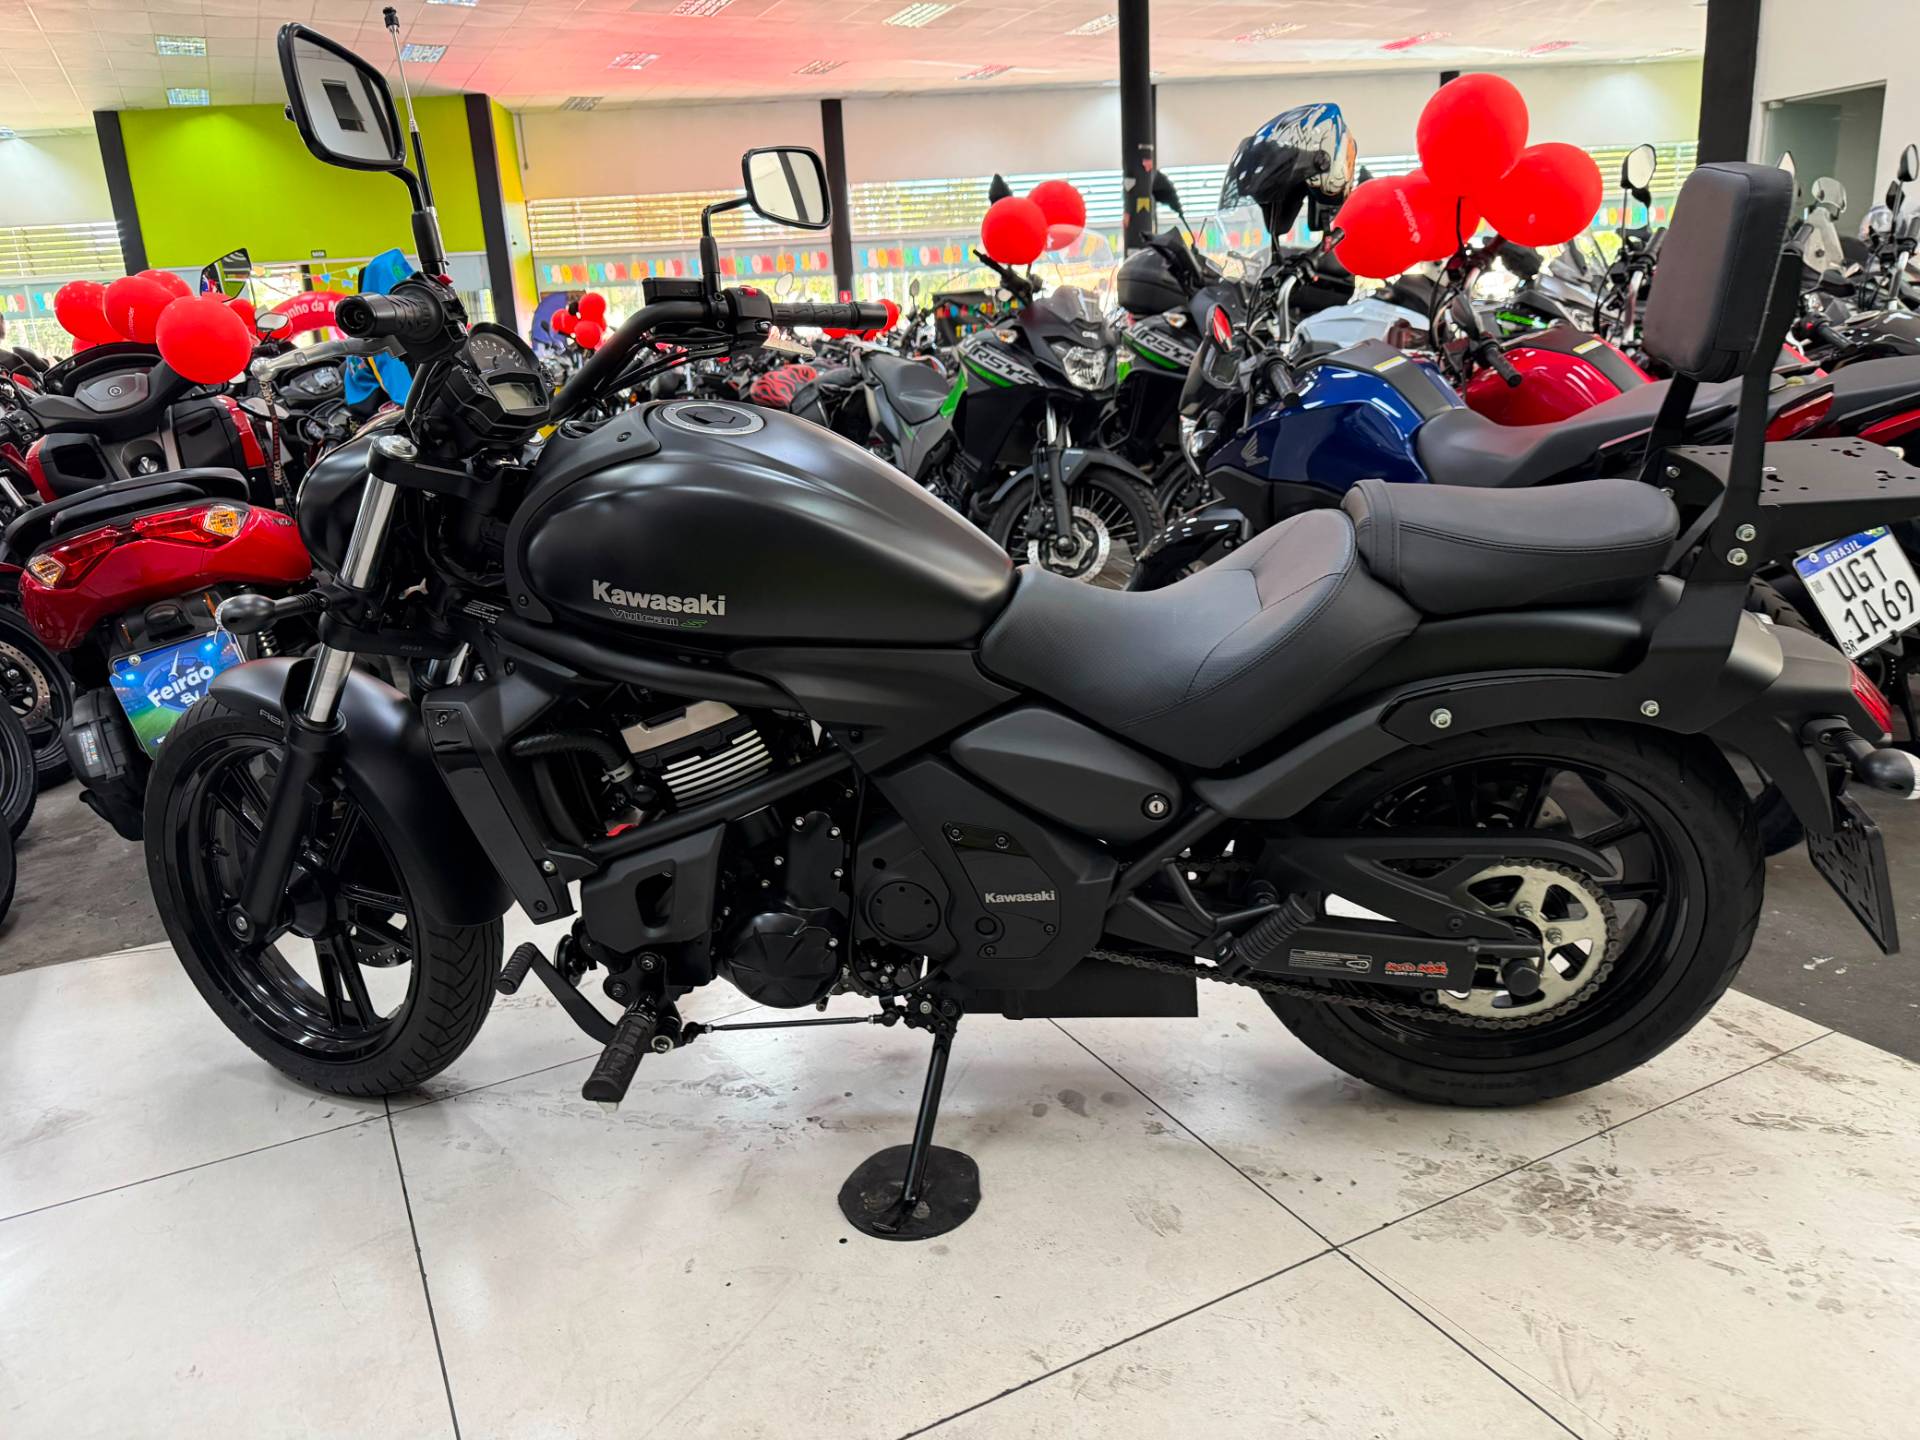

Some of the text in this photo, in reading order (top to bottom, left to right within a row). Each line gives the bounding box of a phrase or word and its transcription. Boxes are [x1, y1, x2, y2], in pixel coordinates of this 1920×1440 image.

[311, 300, 325, 312] da
[1824, 540, 1863, 563] BRASIL
[1827, 548, 1887, 602] UGT
[592, 579, 727, 616] Kawasaki
[609, 607, 679, 627] Vulcan
[1844, 579, 1914, 643] 1A69
[1842, 639, 1858, 654] BR
[147, 665, 214, 708] Feirão
[985, 890, 1056, 904] Kawasaki
